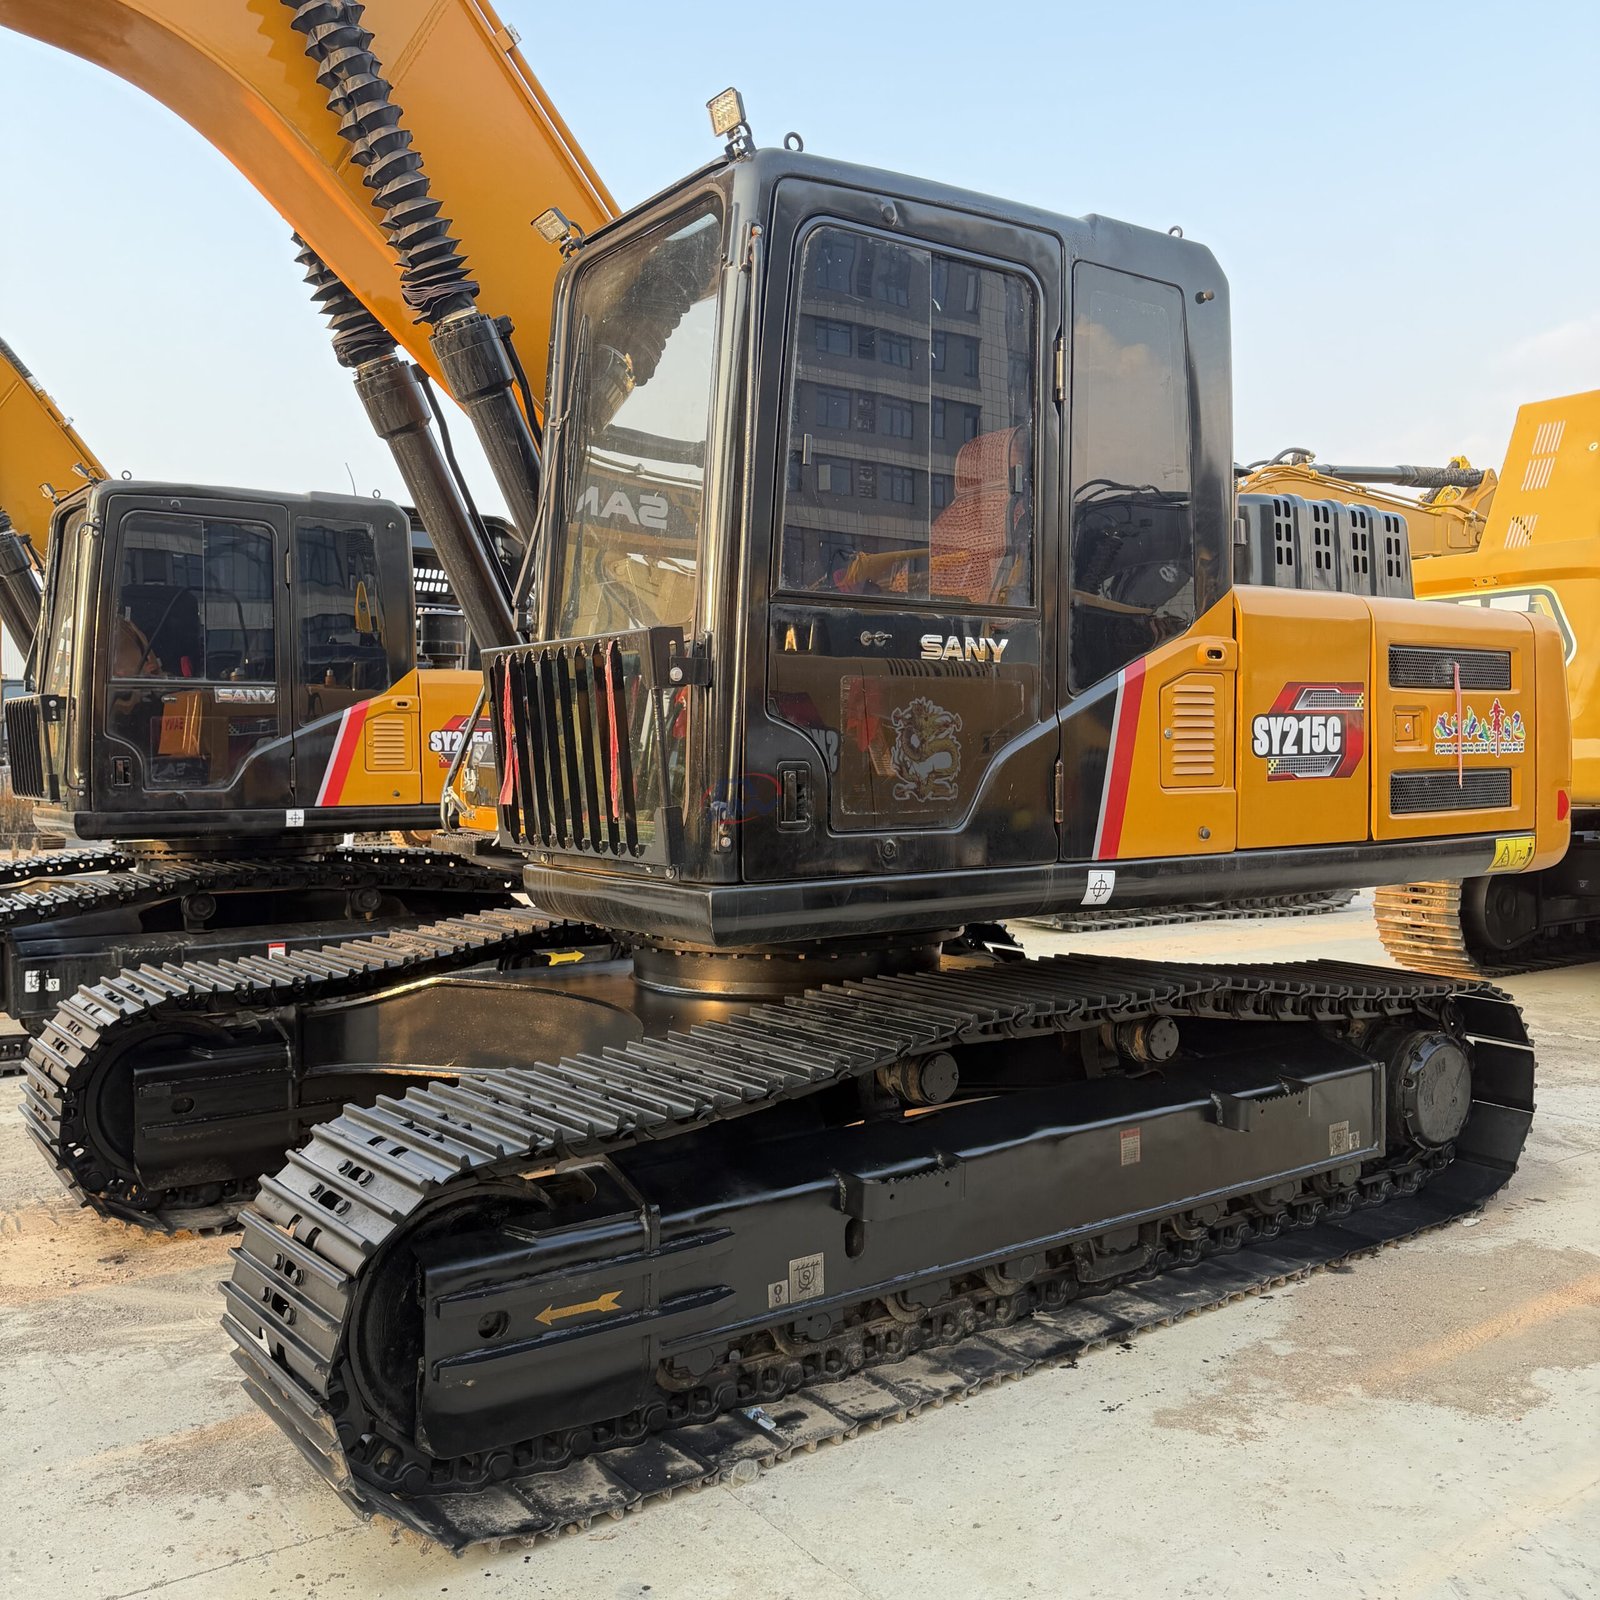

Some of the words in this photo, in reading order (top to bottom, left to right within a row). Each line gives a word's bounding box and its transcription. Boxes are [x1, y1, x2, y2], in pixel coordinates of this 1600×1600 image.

[920, 634, 1009, 663] SANY
[216, 687, 276, 704] SANY
[1253, 715, 1342, 756] SY215C
